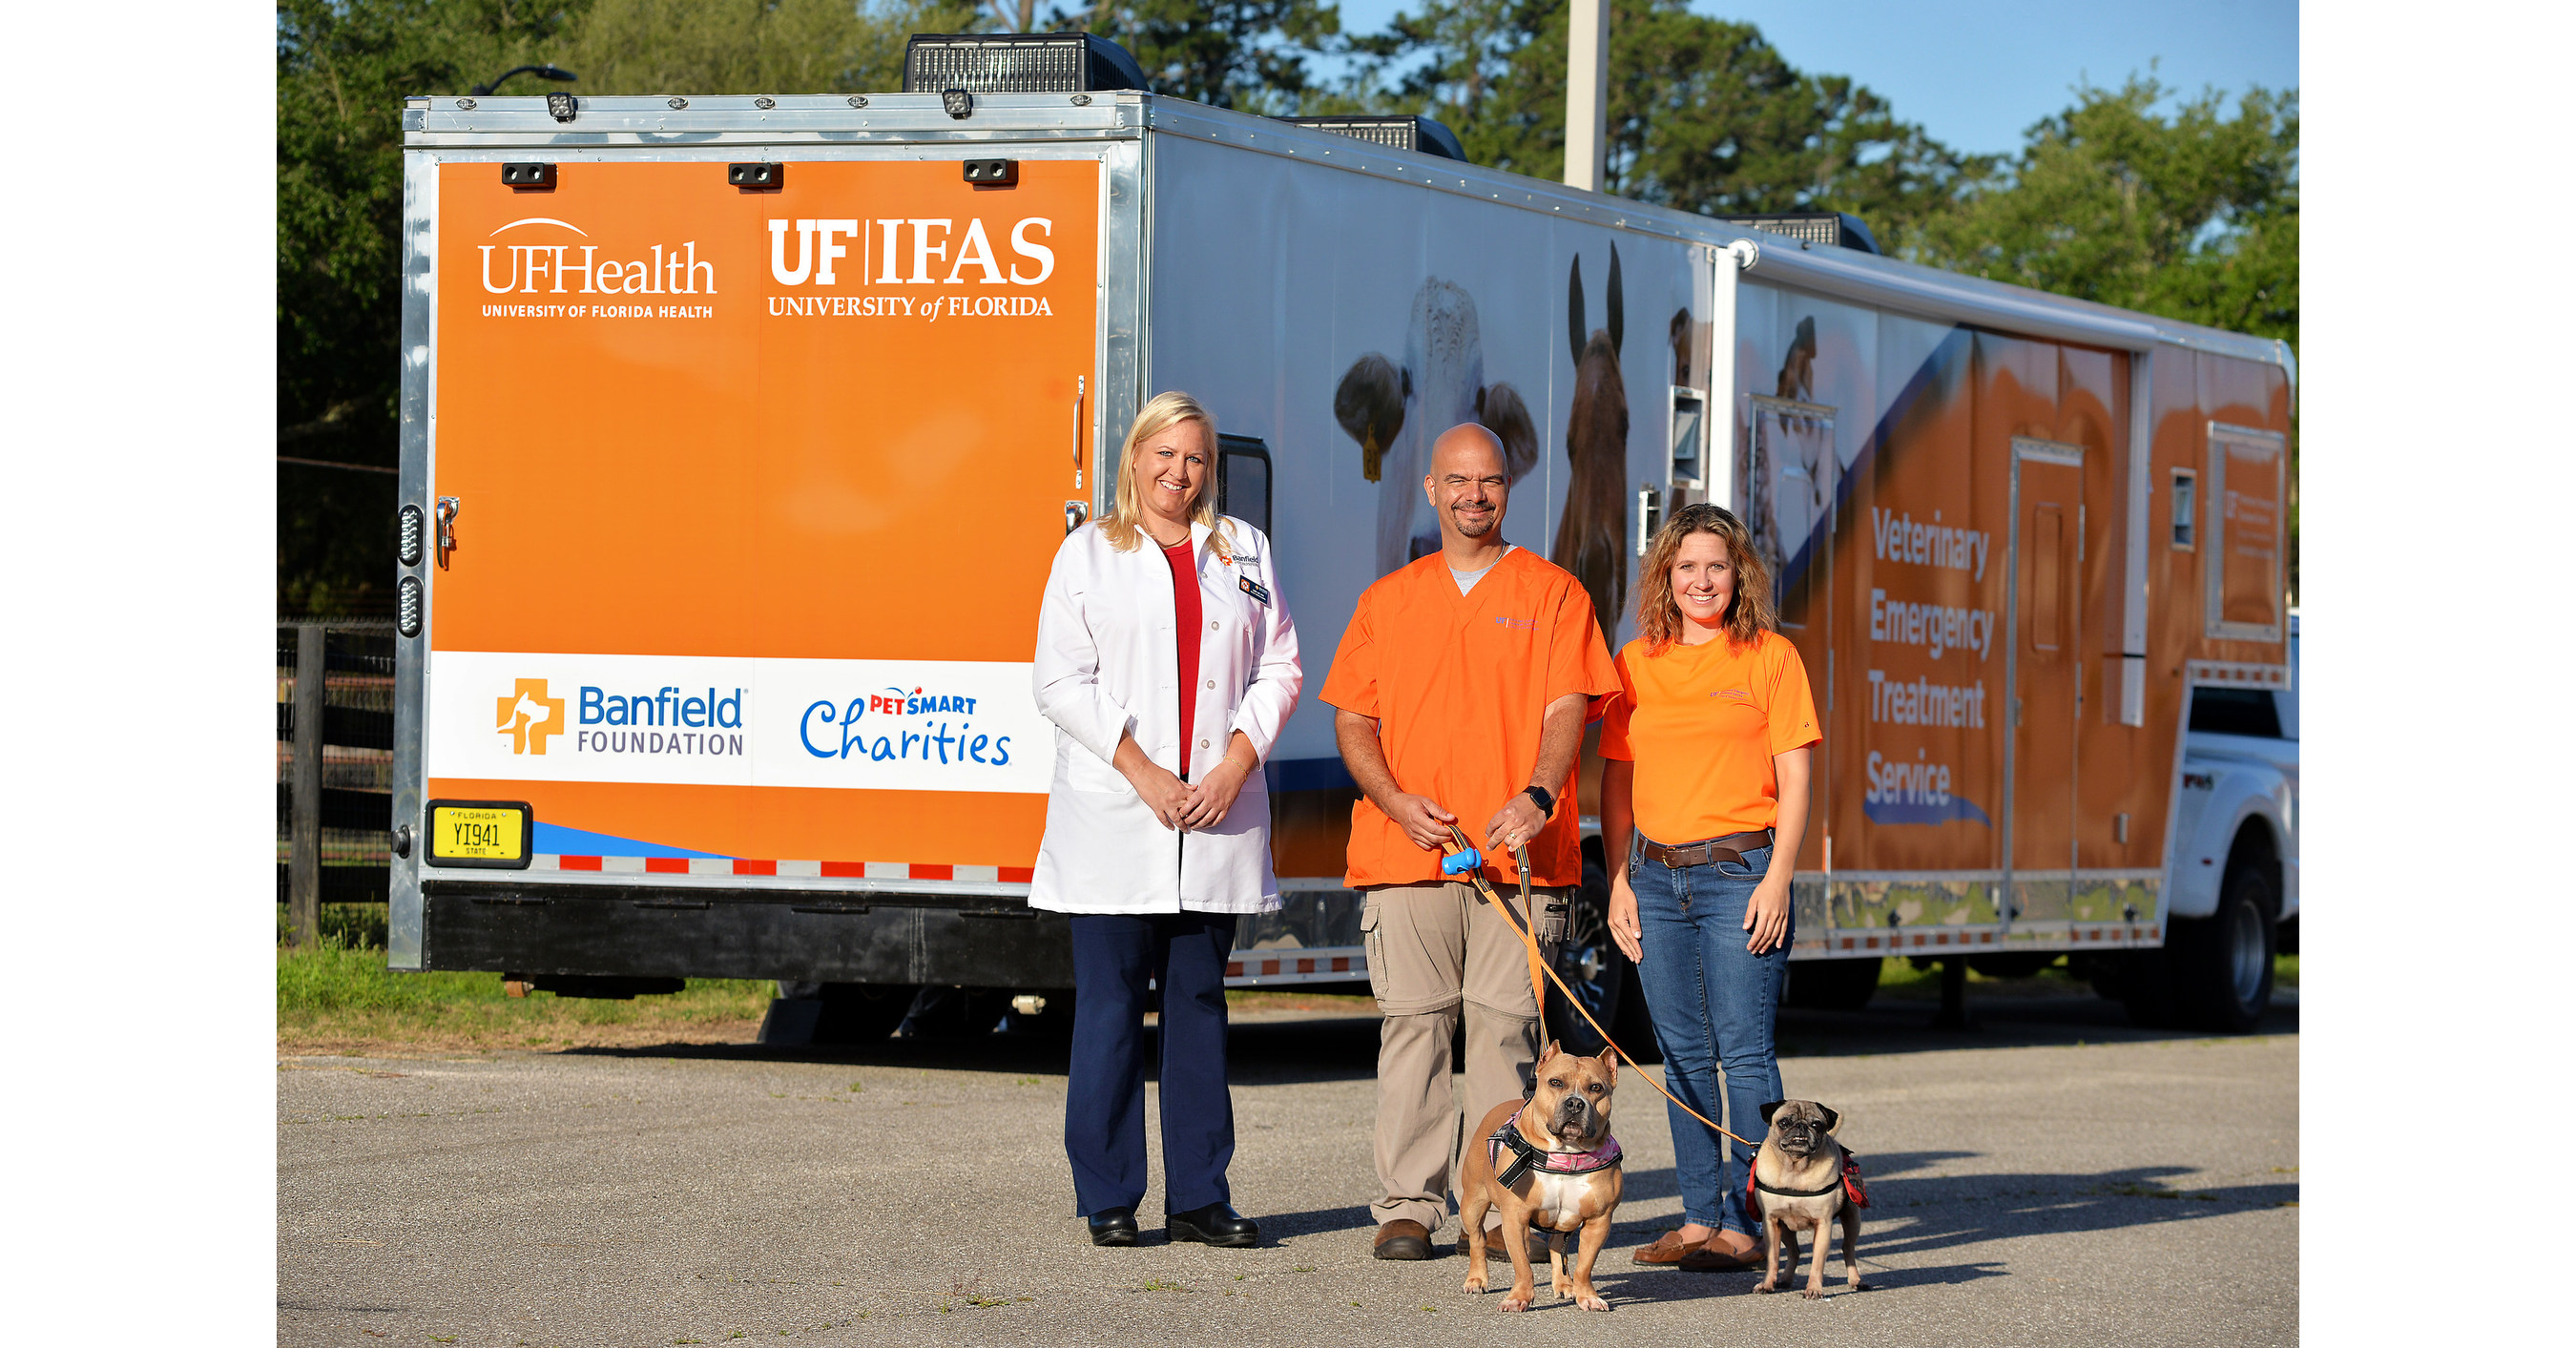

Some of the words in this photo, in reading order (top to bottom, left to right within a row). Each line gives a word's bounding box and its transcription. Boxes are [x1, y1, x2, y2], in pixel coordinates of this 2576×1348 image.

[768, 218, 858, 286] UF
[876, 217, 1055, 286] IFAS
[482, 304, 565, 318] UNIVERSITY
[568, 304, 587, 318] OF
[592, 305, 654, 319] FLORIDA
[658, 305, 713, 319] HEALTH
[767, 297, 916, 316] UNIVERSITY
[921, 296, 945, 322] of
[947, 297, 1053, 316] FLORIDA
[1872, 507, 1989, 583] Veterinary
[1870, 588, 1995, 662] Emergency
[579, 686, 742, 729] Banfield
[1867, 669, 1985, 729] Treatment
[577, 731, 743, 756] FOUNDATION
[800, 697, 1011, 766] Charities
[1866, 747, 1951, 807] Service
[454, 823, 500, 846] YI941
[457, 811, 497, 819] FLORIDA
[466, 847, 487, 856] STATE
